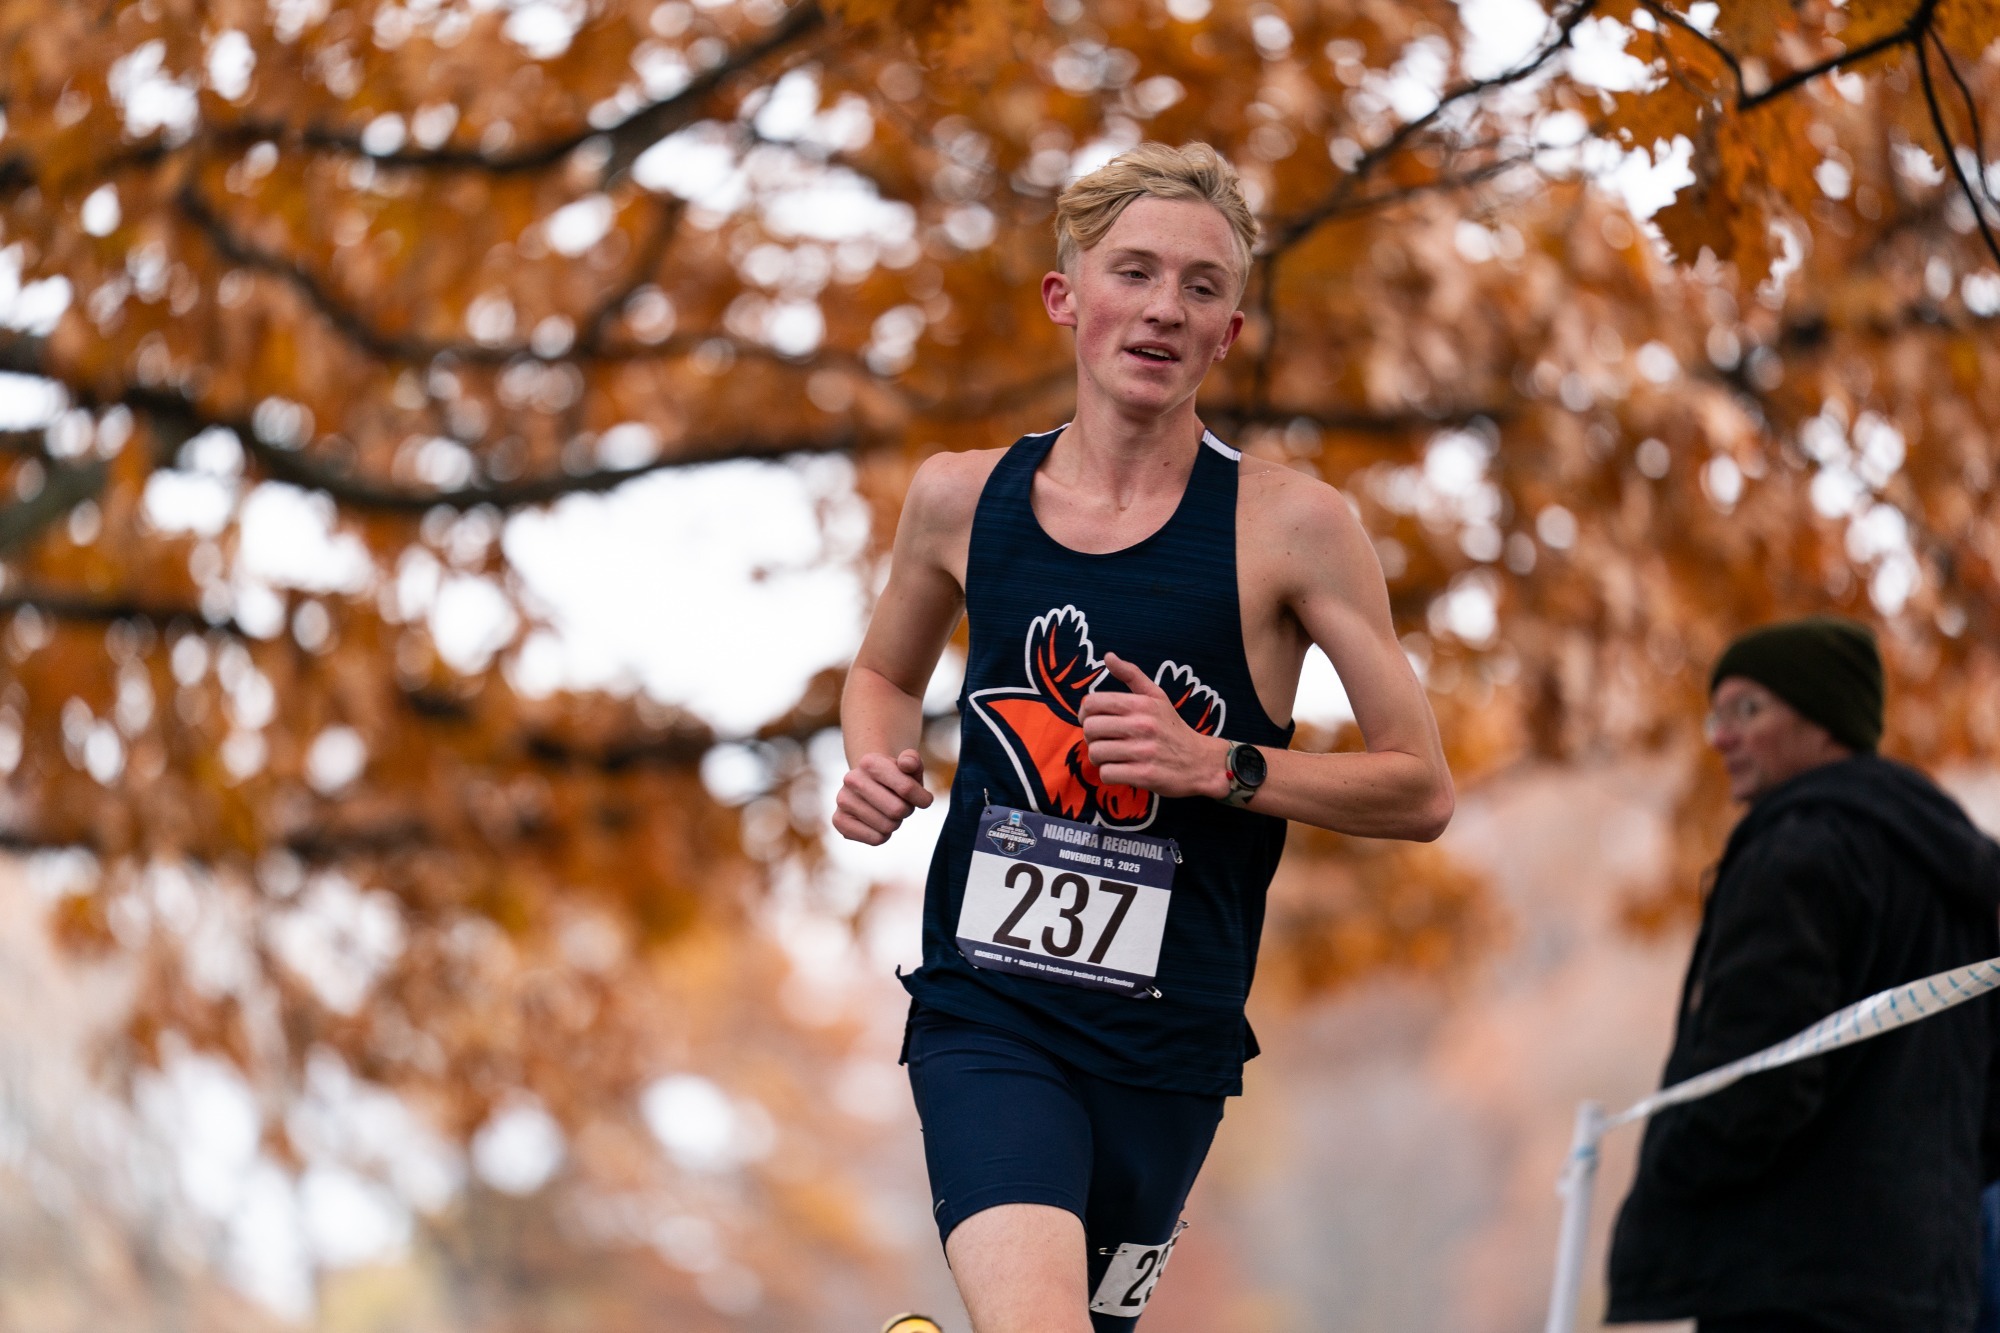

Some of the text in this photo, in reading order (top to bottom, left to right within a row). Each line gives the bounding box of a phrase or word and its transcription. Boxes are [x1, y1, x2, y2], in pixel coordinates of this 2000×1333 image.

[988, 830, 1036, 846] CHAMPIONSHIPS
[1042, 823, 1164, 861] NIAGARA REGIONAL
[1059, 849, 1141, 874] NOVEMBER 15, 2025
[992, 862, 1138, 965] 237
[1018, 959, 1039, 969] Hosted
[1038, 963, 1046, 971] by
[1046, 965, 1074, 976] Rochester
[1103, 976, 1136, 988] Technology
